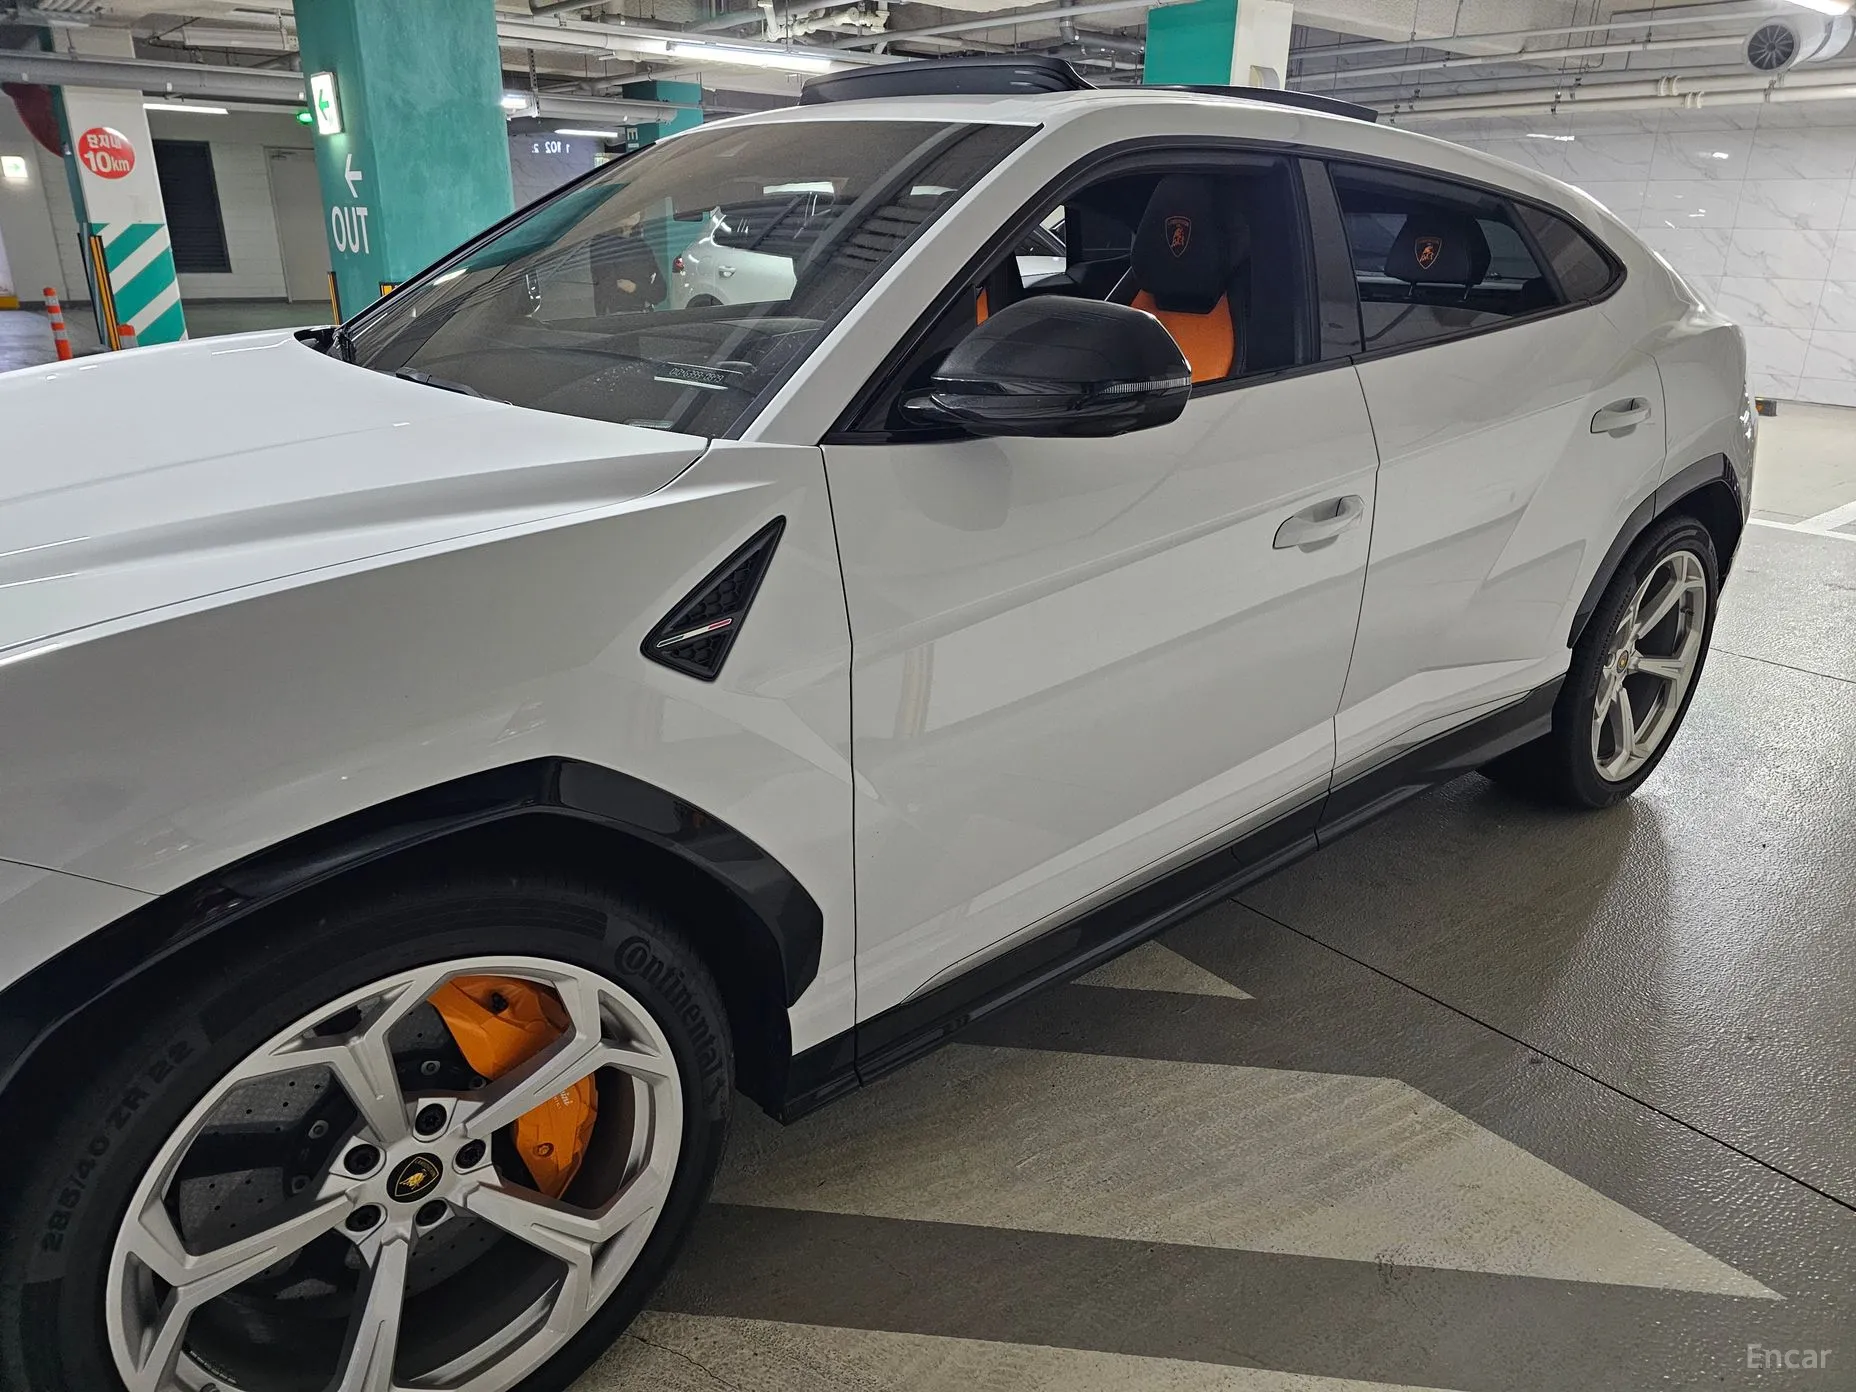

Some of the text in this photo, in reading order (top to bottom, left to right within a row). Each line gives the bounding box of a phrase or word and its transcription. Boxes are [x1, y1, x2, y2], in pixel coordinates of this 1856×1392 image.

[83, 150, 130, 172] 10km
[87, 134, 121, 149] 단지내
[331, 206, 370, 254] OUT
[614, 936, 723, 1079] Continental
[41, 1041, 195, 1252] 285/40 ZR 22
